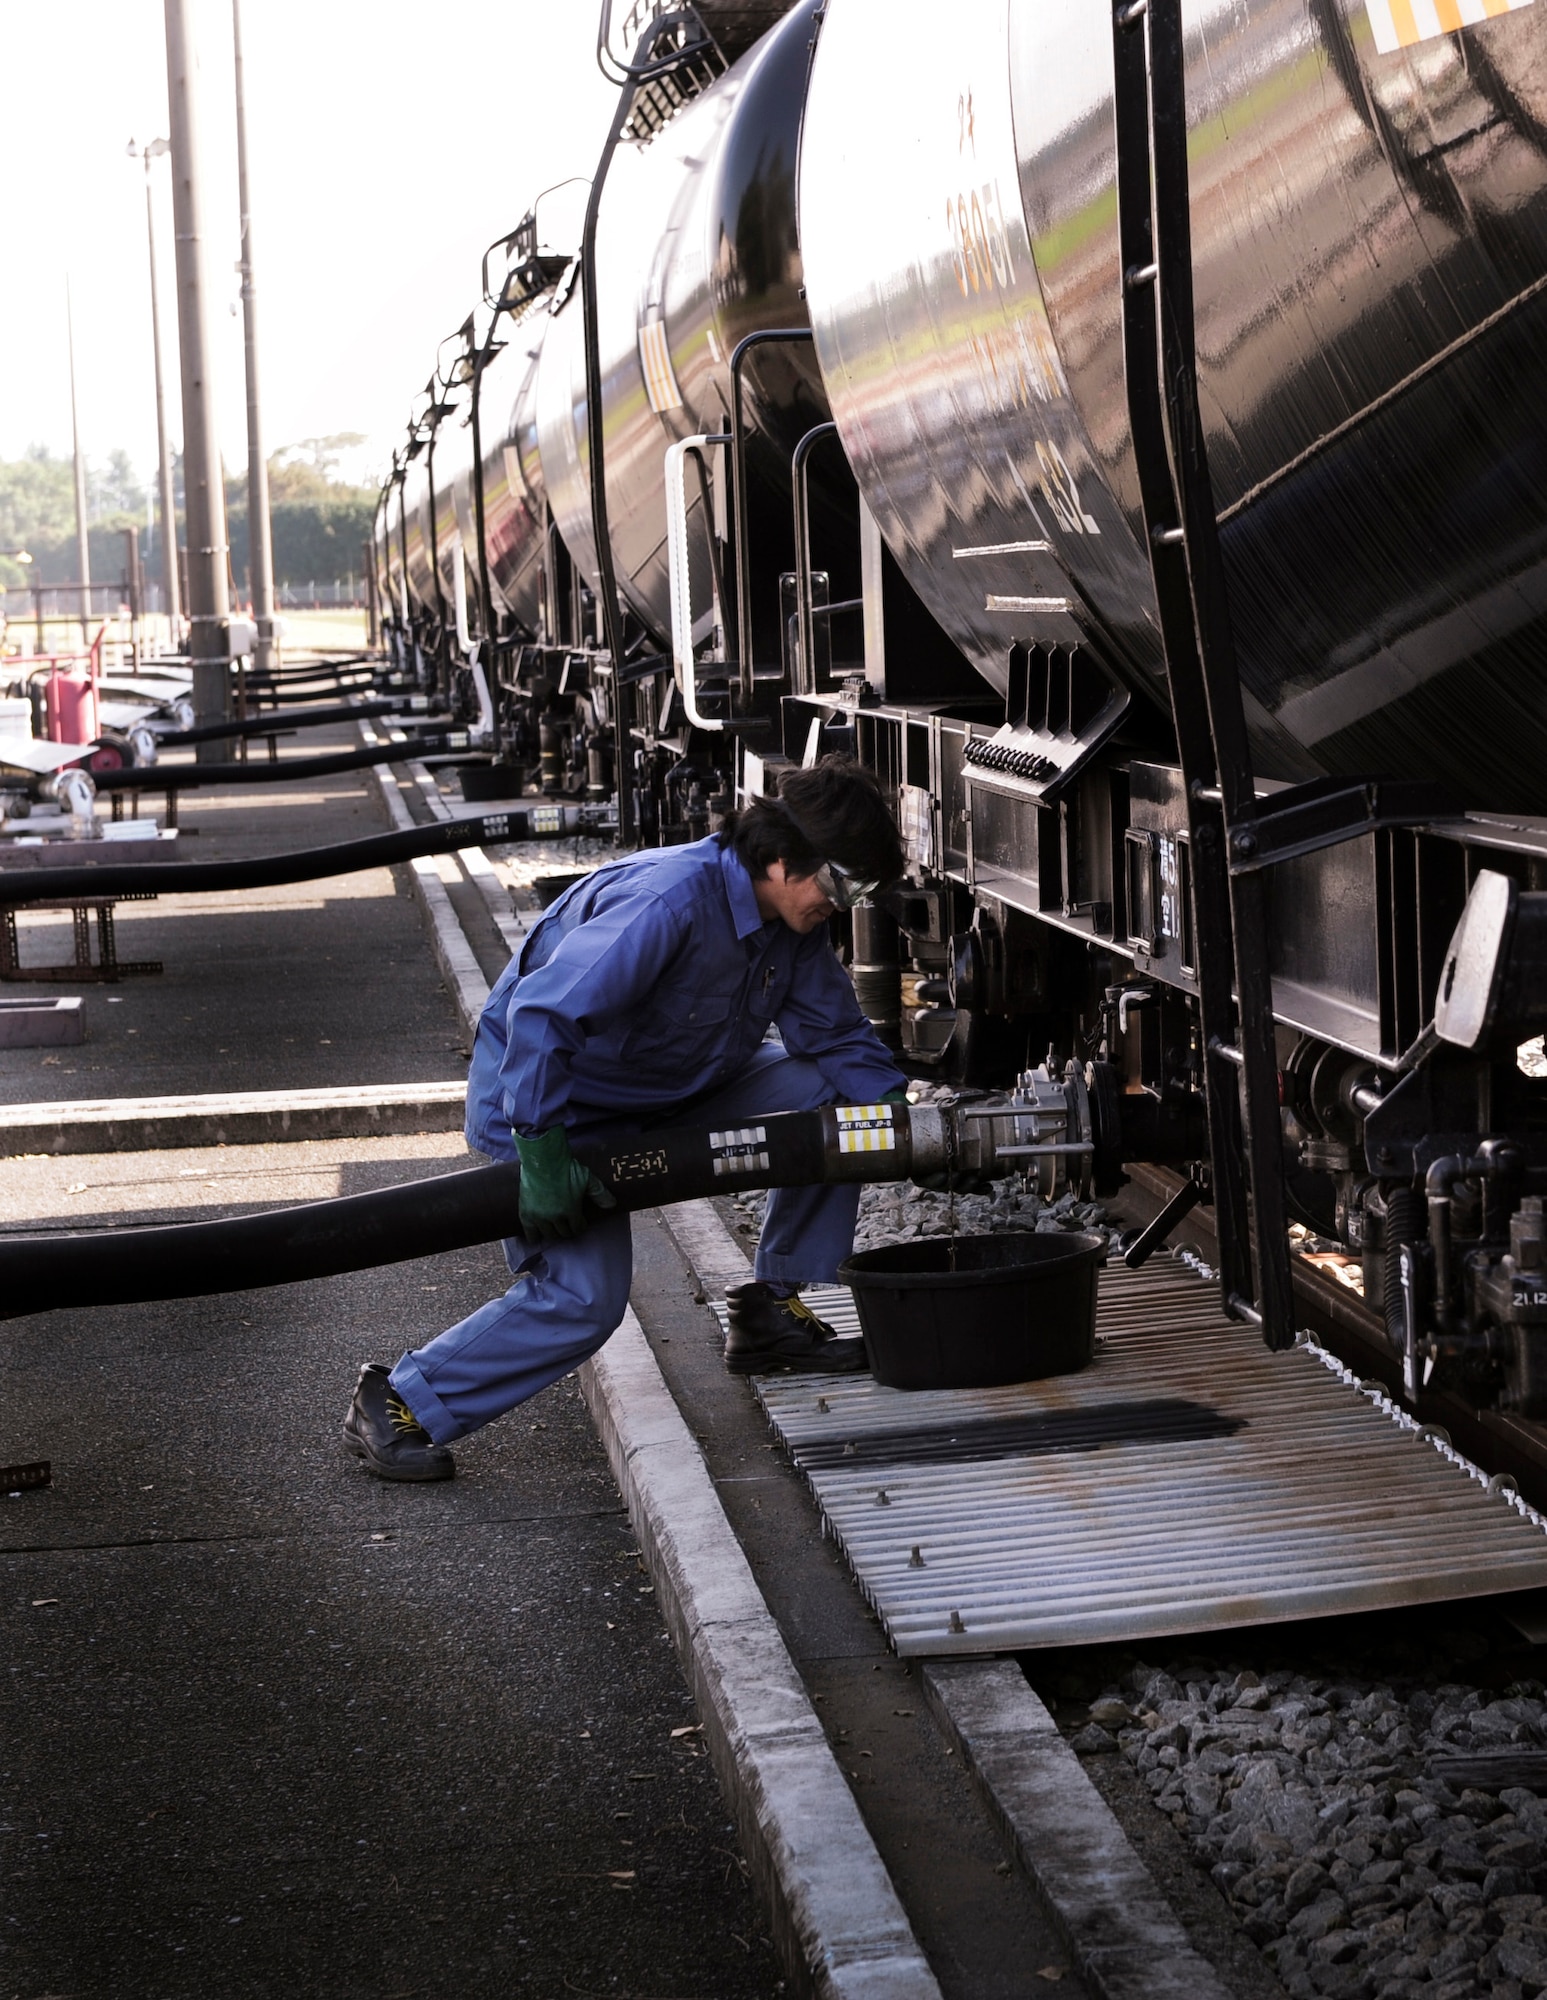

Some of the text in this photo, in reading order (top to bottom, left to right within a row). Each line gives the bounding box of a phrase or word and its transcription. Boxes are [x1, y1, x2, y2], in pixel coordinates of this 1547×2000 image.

[840, 1119, 892, 1130] JET FUEL JP-8
